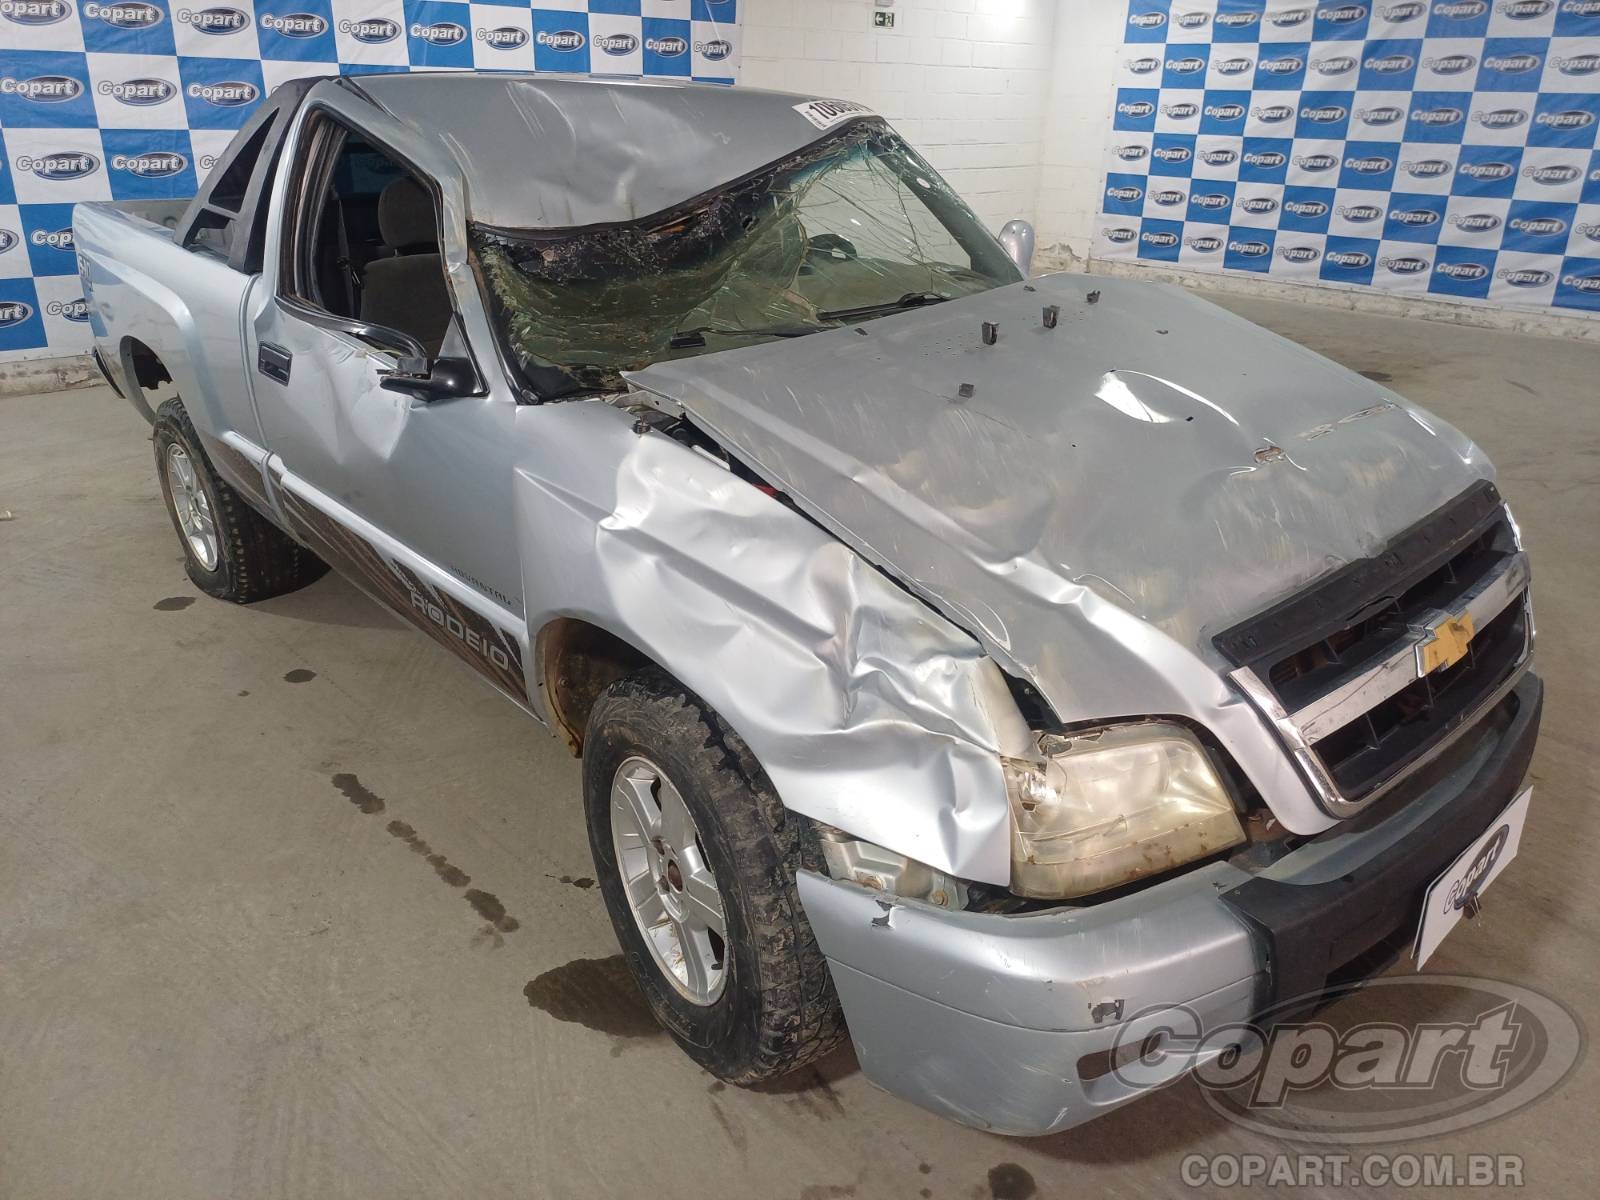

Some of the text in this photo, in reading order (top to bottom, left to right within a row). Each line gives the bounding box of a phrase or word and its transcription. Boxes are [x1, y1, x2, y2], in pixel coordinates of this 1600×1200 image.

[0, 0, 61, 18] opart
[84, 2, 154, 23] Copart
[1317, 7, 1361, 21] Copart
[1374, 3, 1420, 20] Copart
[1433, 2, 1482, 18] Copart
[1562, 1, 1600, 13] Copa
[176, 8, 241, 28] Copart
[260, 14, 321, 33] Copart
[1128, 14, 1162, 26] Copart
[1215, 13, 1254, 26] Copart
[338, 20, 394, 38] Copart
[410, 24, 463, 41] Copart
[475, 28, 524, 44] Copart
[536, 32, 580, 47] Copart
[593, 35, 634, 50] Copart
[645, 39, 683, 52] Copart
[1165, 59, 1202, 72] Copart
[1258, 59, 1300, 72] Copart
[1310, 57, 1352, 73] Copart
[1364, 57, 1410, 72] Copart
[1422, 56, 1472, 73] Copart
[1483, 56, 1535, 72] Copart
[0, 76, 75, 98] Copart
[98, 81, 168, 102] Copart
[187, 84, 252, 102] Copart
[1117, 102, 1152, 115] Copart
[1160, 104, 1195, 116] Copart
[1204, 105, 1241, 118] Copart
[1250, 106, 1290, 120] Copart
[1300, 106, 1343, 121] Copart
[1353, 107, 1399, 122] Copart
[1410, 108, 1458, 123] Copart
[1471, 109, 1523, 125] Copart
[1535, 110, 1591, 127] Copart
[1112, 146, 1146, 158] Copart
[1153, 147, 1188, 160] Copart
[1198, 150, 1234, 163] Copart
[1243, 152, 1281, 165] Copart
[16, 154, 90, 175] Copart
[111, 154, 180, 174] Copart
[1292, 155, 1334, 169] Copart
[1344, 157, 1388, 171] Copart
[1400, 160, 1447, 175] Copart
[1458, 163, 1509, 178] Copart
[1522, 166, 1576, 182] Copart
[1106, 187, 1140, 199] Copart
[1148, 190, 1182, 203] Copart
[1190, 194, 1226, 206] Copart
[1236, 198, 1275, 210] Copart
[1284, 201, 1323, 215] Copart
[1335, 206, 1378, 220] Copart
[1389, 210, 1435, 224] Copart
[1448, 214, 1496, 229] Copart
[1510, 218, 1562, 232] Copart
[31, 229, 73, 247] Cop
[1142, 232, 1174, 244] Copart
[1228, 240, 1266, 254] Copart
[1325, 251, 1367, 267] Copart
[1379, 258, 1425, 272] Copart
[1436, 262, 1484, 277] Copart
[1496, 268, 1550, 283] Copart
[1562, 273, 1600, 290] Copa
[47, 301, 88, 319] Cop
[411, 590, 509, 671] RODEIO
